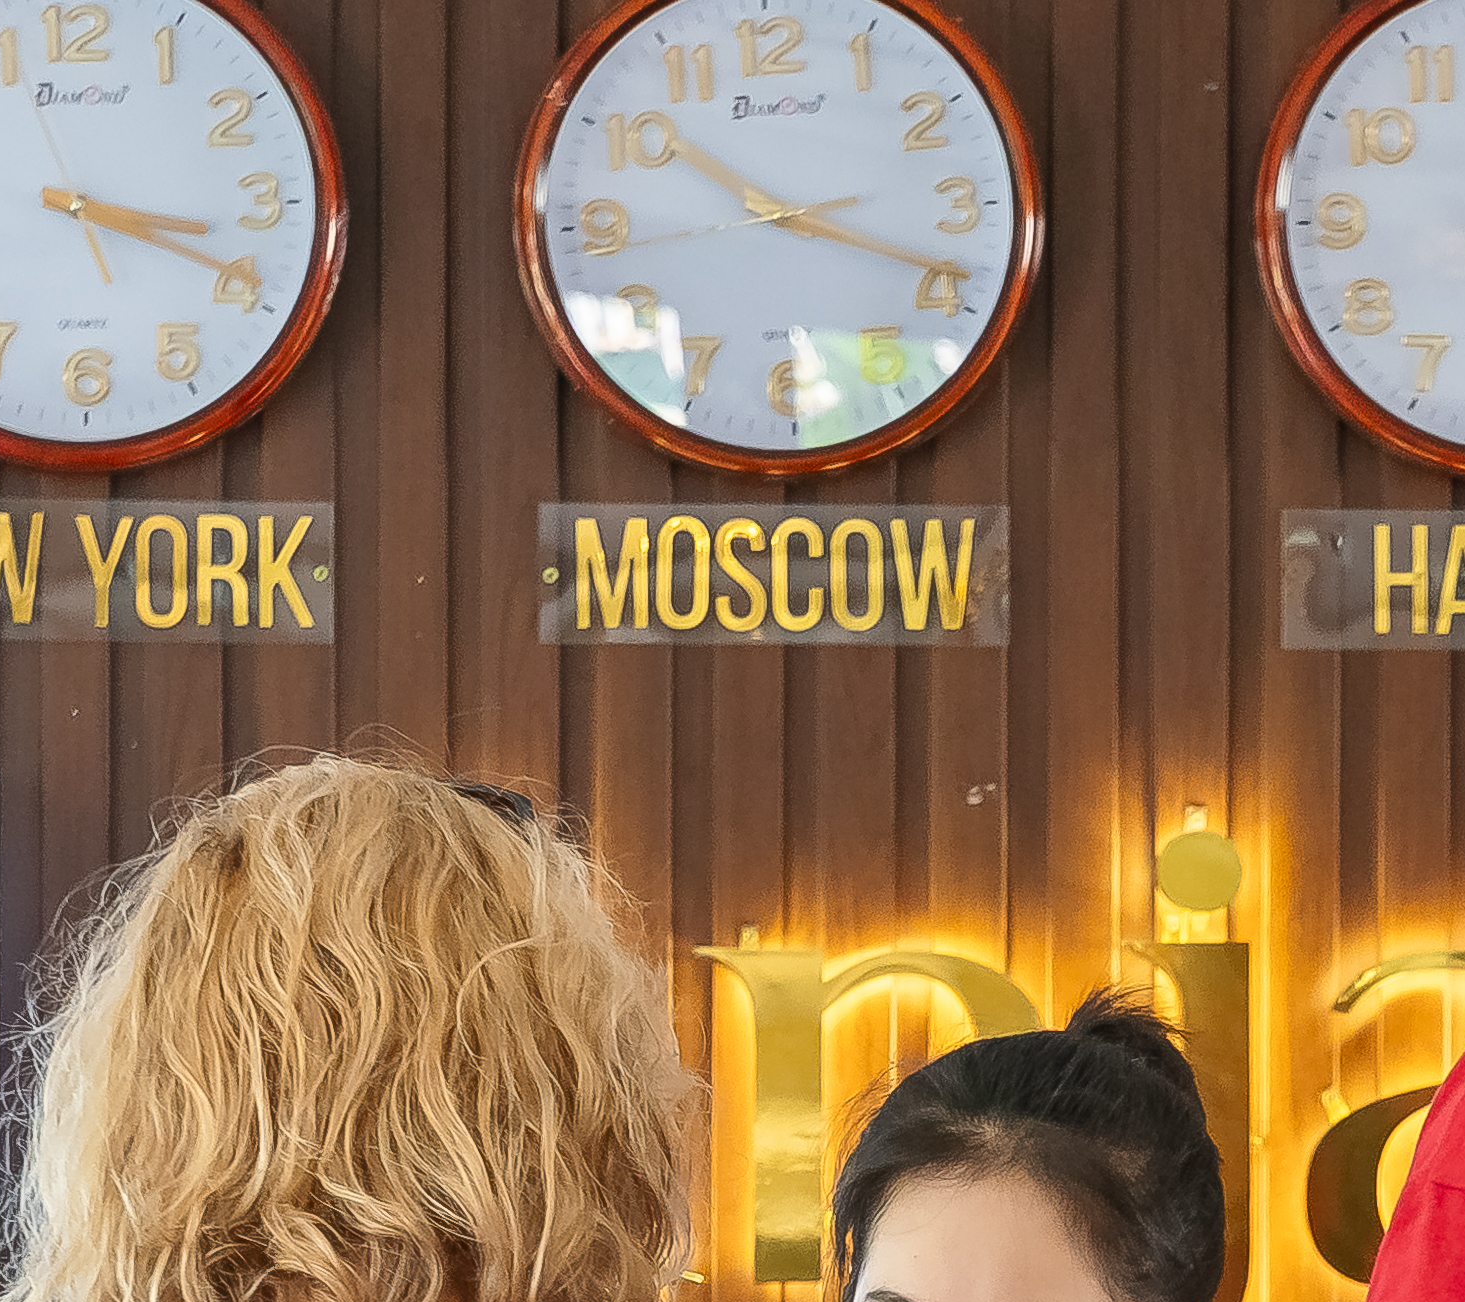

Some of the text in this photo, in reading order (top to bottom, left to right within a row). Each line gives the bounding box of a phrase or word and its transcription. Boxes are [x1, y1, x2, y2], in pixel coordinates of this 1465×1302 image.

[41, 5, 110, 62] 12
[153, 26, 176, 85] 1
[734, 16, 806, 78] 12
[848, 33, 873, 92] 1
[663, 45, 714, 103] 11
[1405, 45, 1454, 102] 11
[206, 89, 255, 148] 2
[606, 110, 678, 171] 10
[902, 91, 949, 151] 2
[1345, 108, 1416, 166] 10
[237, 172, 281, 231] 3
[581, 199, 628, 256] 9
[935, 177, 979, 234] 3
[1317, 193, 1367, 249] 9
[213, 255, 263, 314] 4
[915, 261, 969, 317] 4
[1344, 278, 1395, 335] 8
[63, 348, 112, 406] 6
[155, 323, 201, 381] 5
[682, 335, 721, 395] 7
[860, 326, 905, 383] 5
[1402, 334, 1450, 391] 7
[74, 513, 315, 630] YORK
[574, 515, 976, 632] MOSCOW
